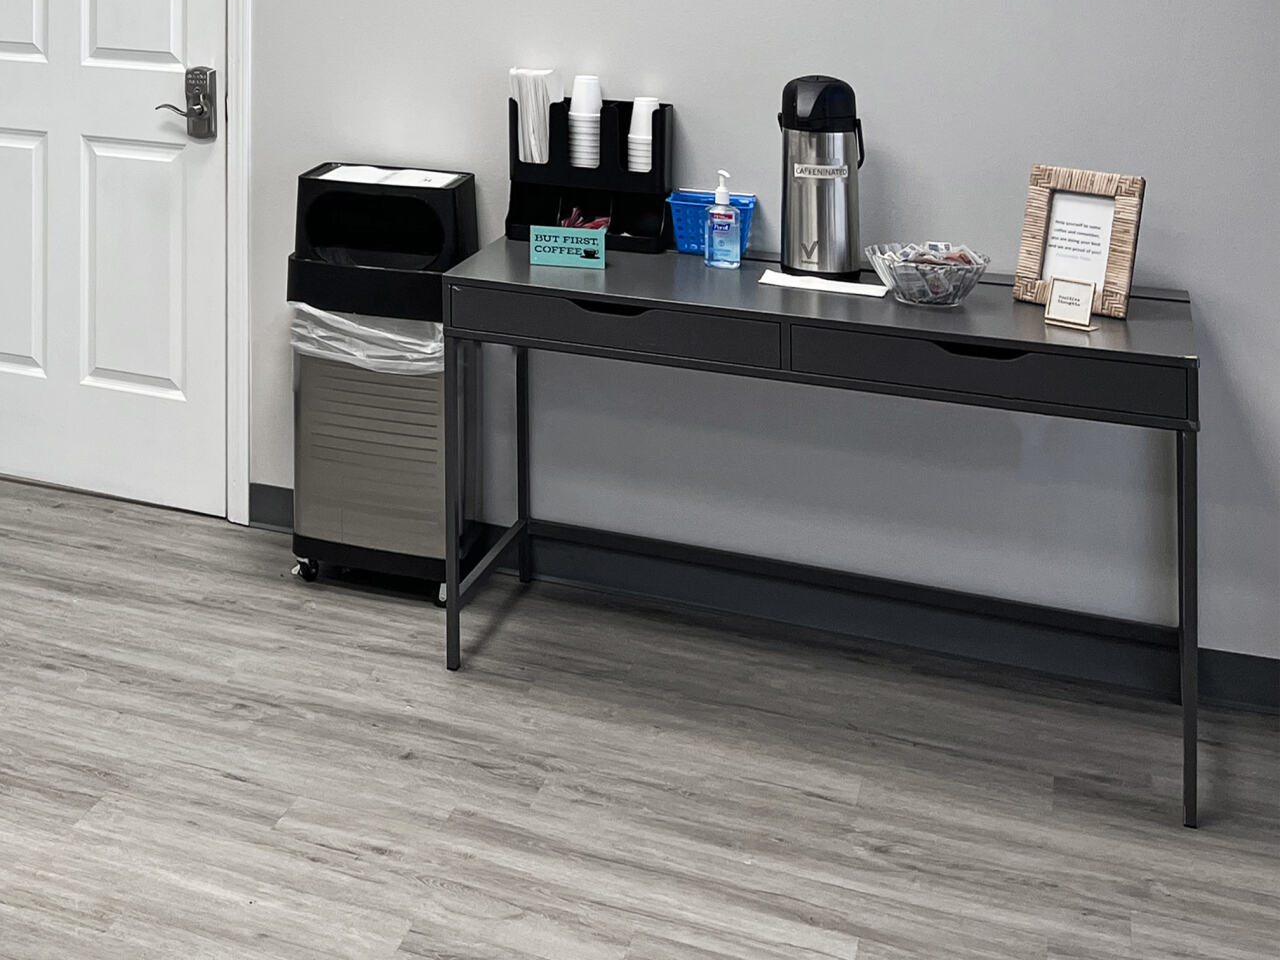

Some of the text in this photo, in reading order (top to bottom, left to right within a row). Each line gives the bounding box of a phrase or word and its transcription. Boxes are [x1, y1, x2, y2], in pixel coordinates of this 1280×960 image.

[534, 234, 599, 246] BUT FIRST,
[534, 245, 582, 256] COFFEE
